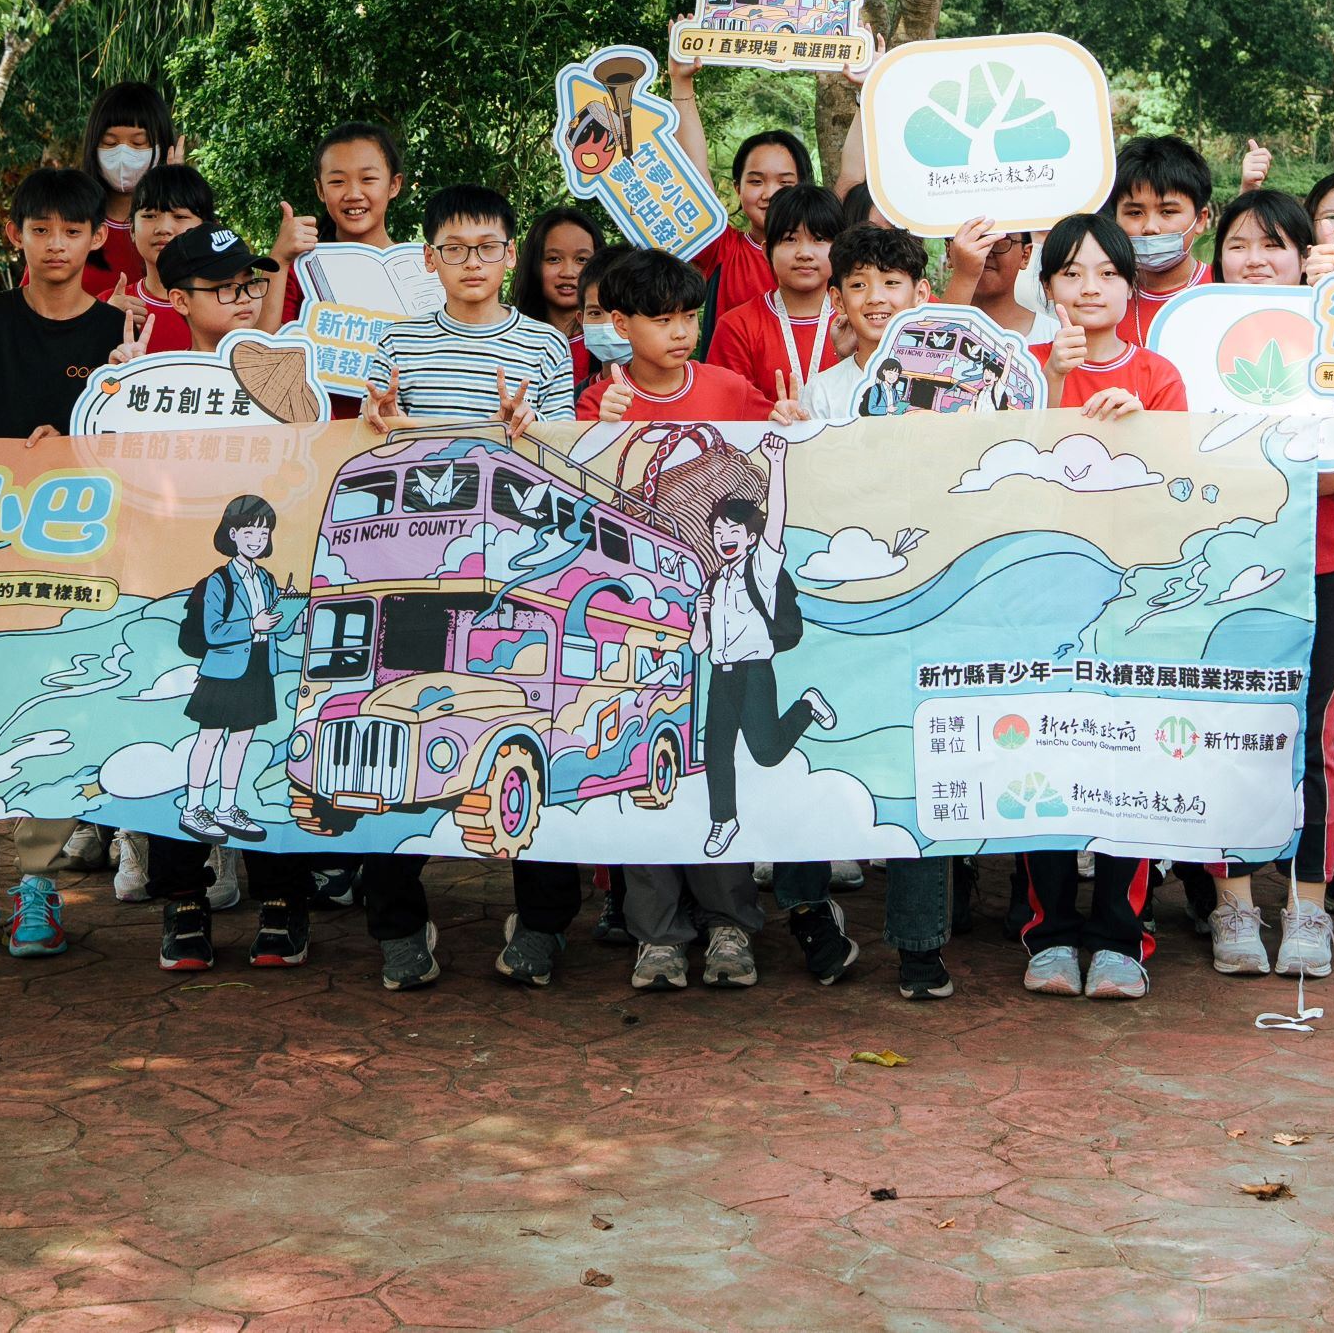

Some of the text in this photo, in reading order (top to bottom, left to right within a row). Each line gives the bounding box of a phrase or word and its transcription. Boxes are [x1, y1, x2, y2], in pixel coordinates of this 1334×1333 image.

[928, 164, 1055, 188] 新竹縣政府教育局
[211, 230, 235, 245] NIKE
[127, 385, 252, 416] 地方創生是
[331, 519, 468, 546] HSINCHU COUNTY
[918, 661, 1303, 692] 新竹縣青少年一日永續發展職業探索活動
[929, 716, 966, 734] 指導
[1038, 714, 1137, 742] 新竹縣政府
[929, 736, 966, 755] 單位
[1036, 738, 1141, 752] HsinChu County Government
[1204, 732, 1288, 751] 新竹縣議會
[932, 781, 968, 800] 主辦
[1071, 783, 1206, 816] 新竹縣政府教育局
[932, 803, 969, 822] 單位
[1071, 805, 1098, 813] Education
[1122, 812, 1148, 820] HsinChu
[1149, 814, 1170, 822] County
[1171, 816, 1207, 824] Government
